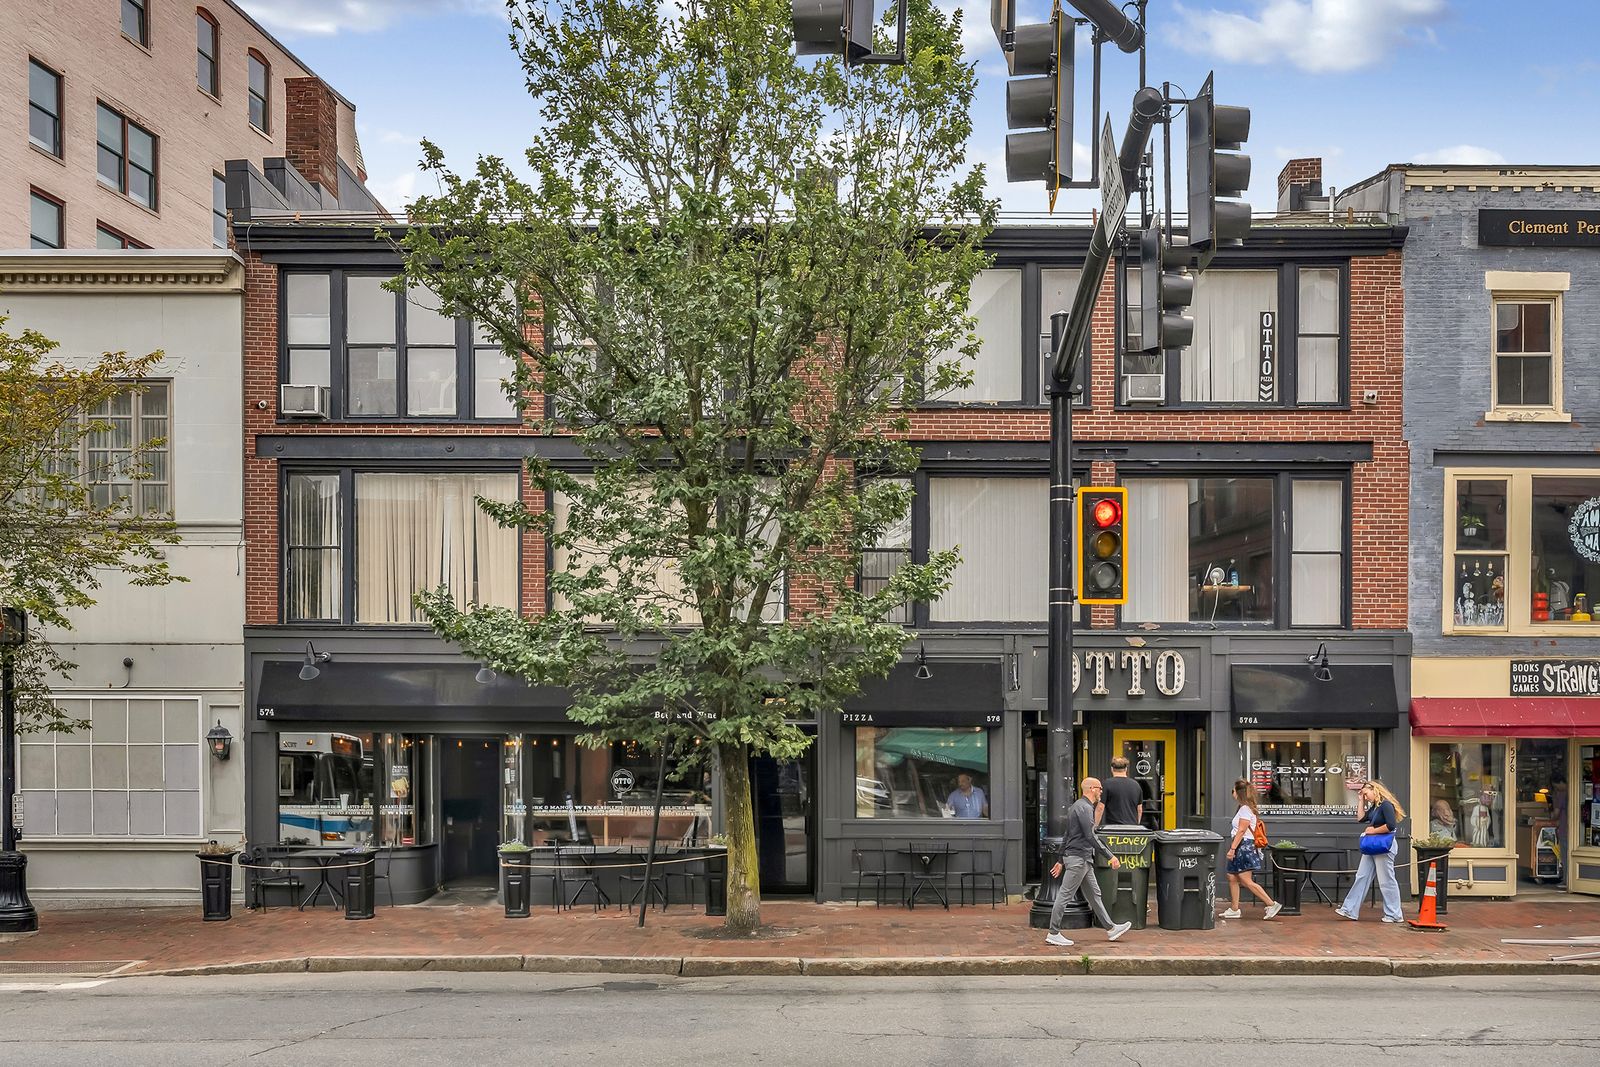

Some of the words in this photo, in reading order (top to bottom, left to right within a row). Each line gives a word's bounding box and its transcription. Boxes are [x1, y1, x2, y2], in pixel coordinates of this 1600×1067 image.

[1509, 220, 1569, 234] Clement
[1262, 312, 1273, 376] OTTO
[1512, 663, 1540, 672] BOOKS
[1073, 649, 1186, 696] TTO
[1512, 674, 1540, 684] VIDEO
[1542, 663, 1600, 693] STRANG
[1512, 684, 1540, 693] GAMES
[259, 708, 275, 716] 574
[676, 711, 693, 719] and
[843, 714, 874, 722] PIZZA
[1239, 716, 1258, 724] 576A
[1276, 766, 1343, 774] ENZO
